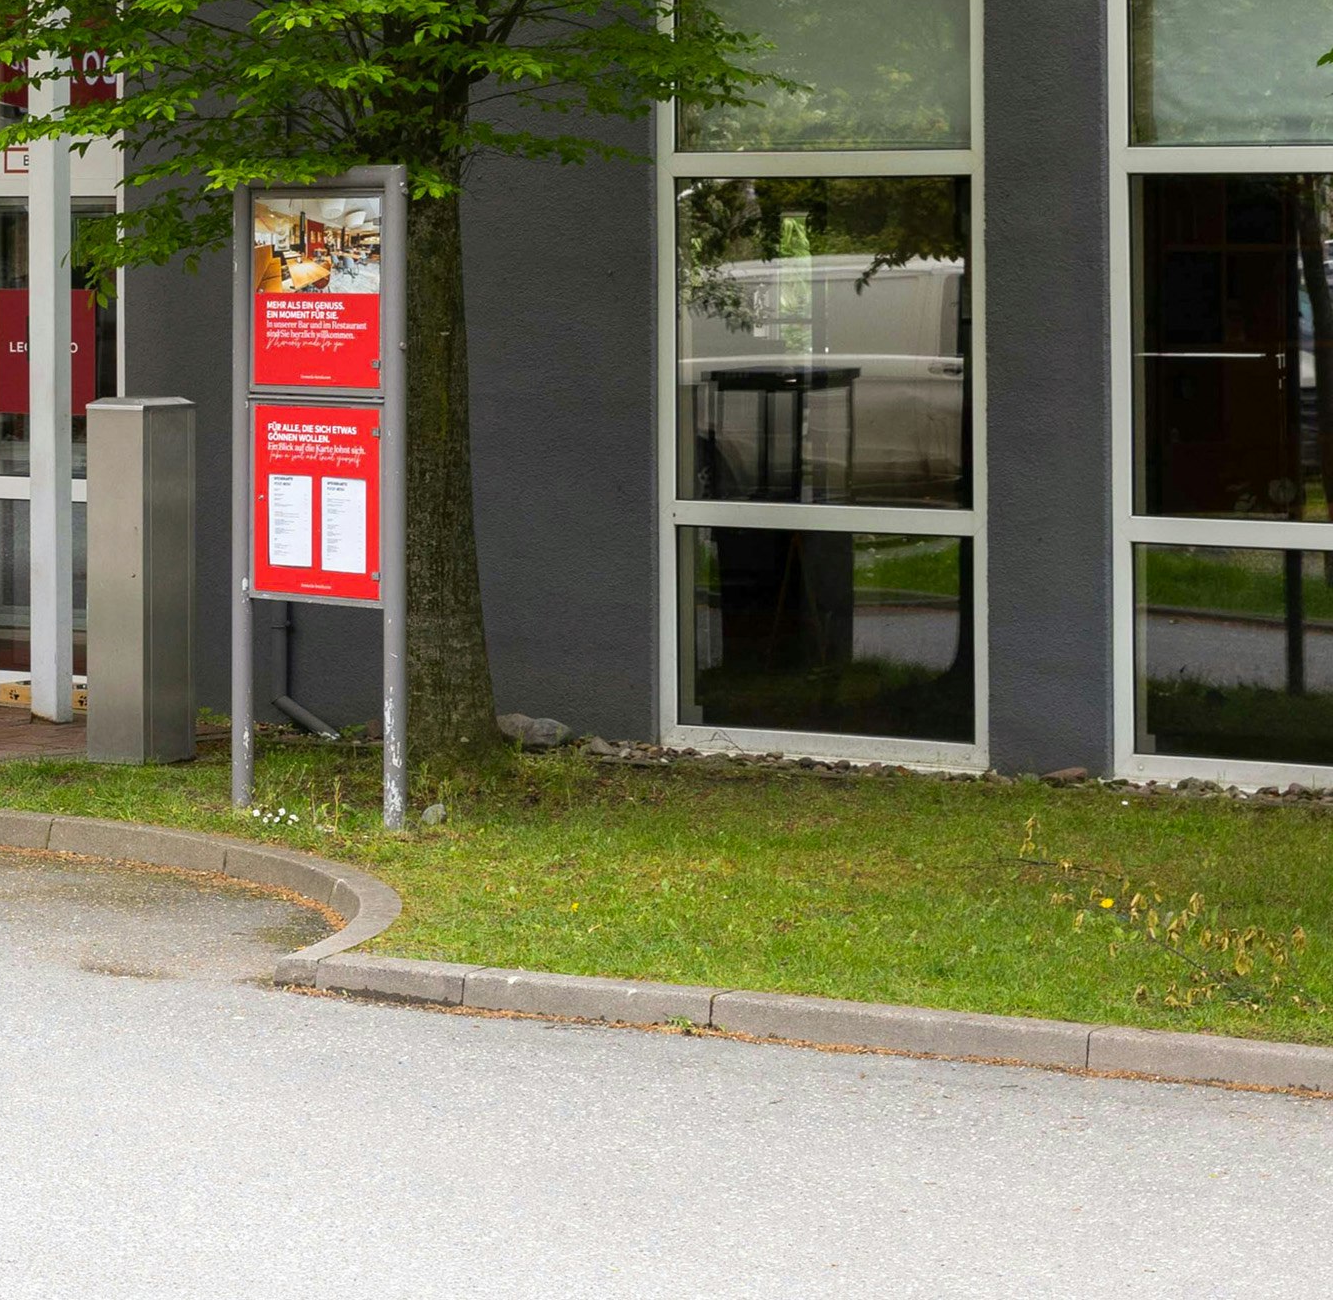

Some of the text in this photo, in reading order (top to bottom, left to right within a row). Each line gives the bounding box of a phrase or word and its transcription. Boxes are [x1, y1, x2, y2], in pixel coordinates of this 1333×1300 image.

[267, 301, 344, 310] MEHR ALS EIN GENUSS.
[267, 309, 338, 319] EIN MOMENT FÜR SIE.
[267, 320, 273, 328] In
[310, 321, 322, 329] und
[323, 321, 331, 329] im
[332, 321, 367, 330] Restaurant
[290, 330, 315, 339] herzlich
[268, 421, 281, 431] FÜR
[282, 424, 301, 433] ALLE,
[315, 425, 331, 433] SICH
[332, 426, 357, 435] ETWAS
[268, 431, 330, 443] GÖNNEN WOLLEN.
[295, 443, 306, 452] auf
[305, 444, 315, 452] die
[316, 444, 333, 453] Karte
